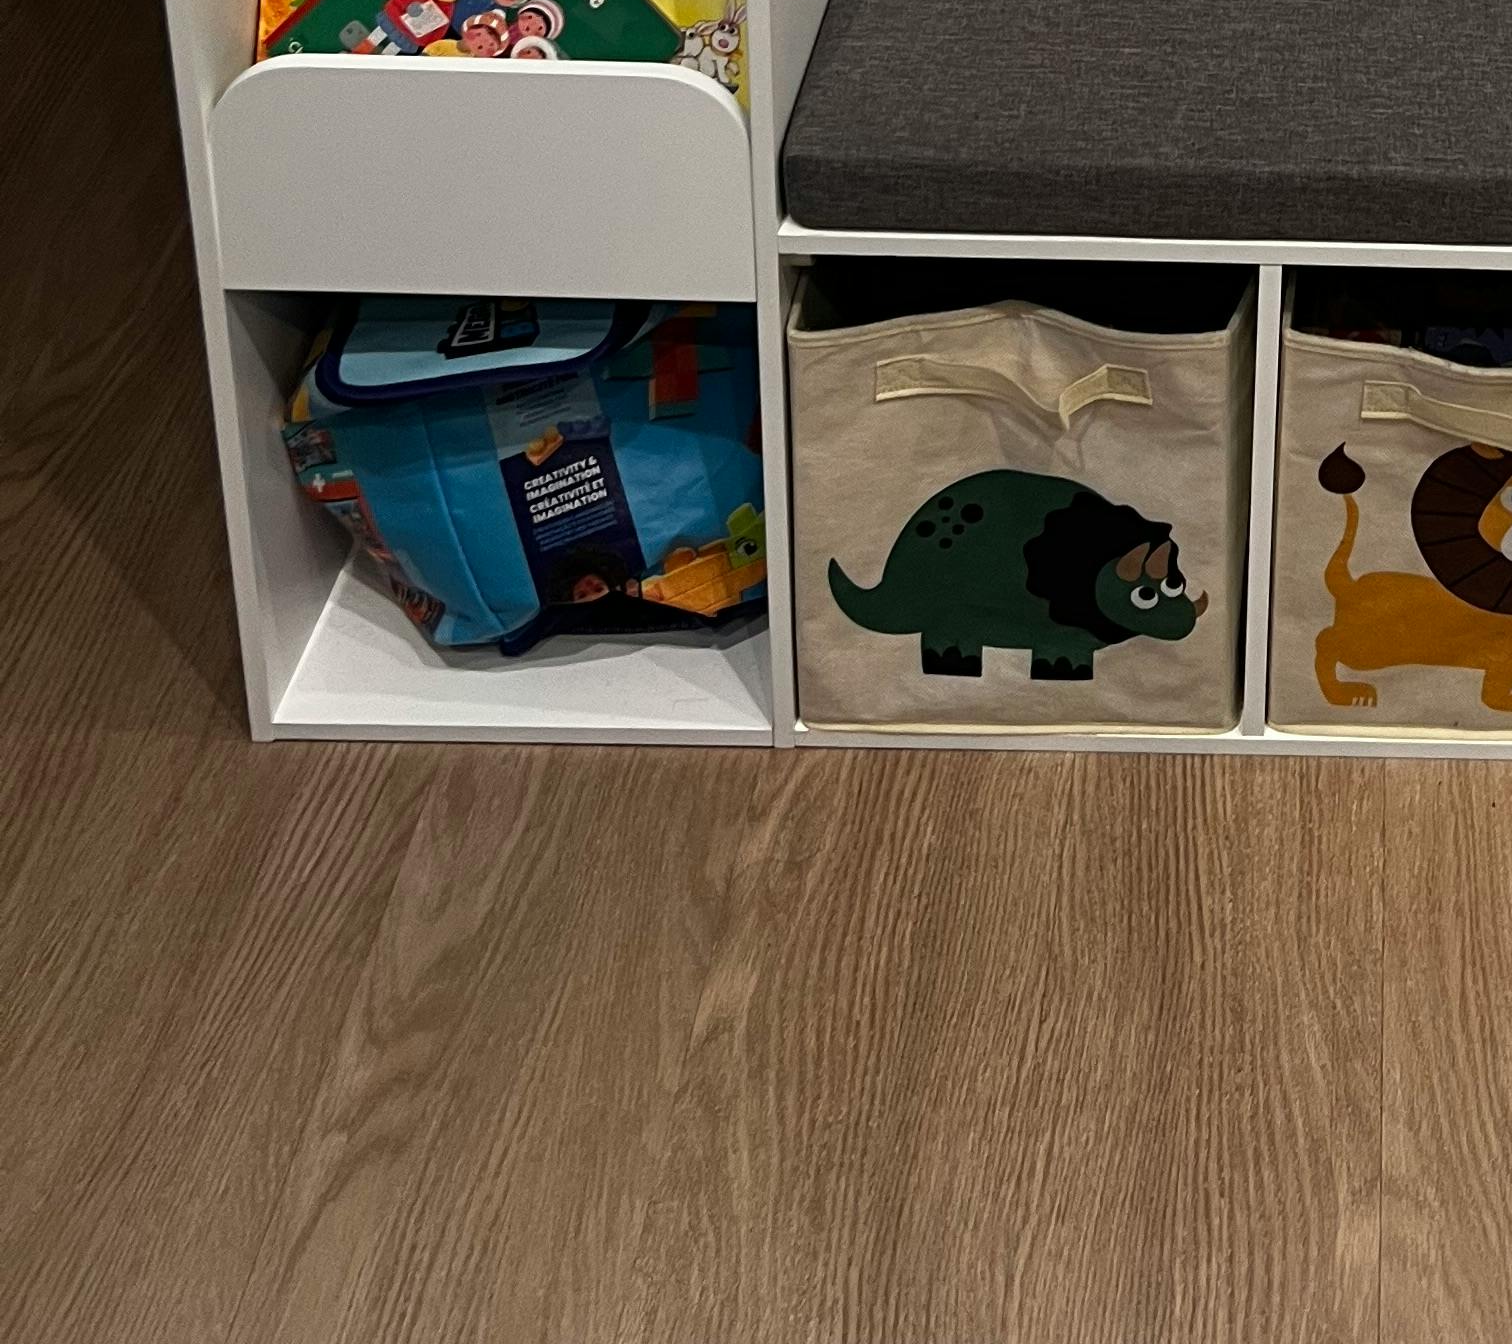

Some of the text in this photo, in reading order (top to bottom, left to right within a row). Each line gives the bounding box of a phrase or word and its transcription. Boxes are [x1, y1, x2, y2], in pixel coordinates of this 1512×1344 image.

[524, 459, 588, 491] CREATIVITY
[526, 465, 601, 501] IMAGINATION
[592, 478, 605, 490] ET
[532, 488, 607, 524] IMAGINATION
